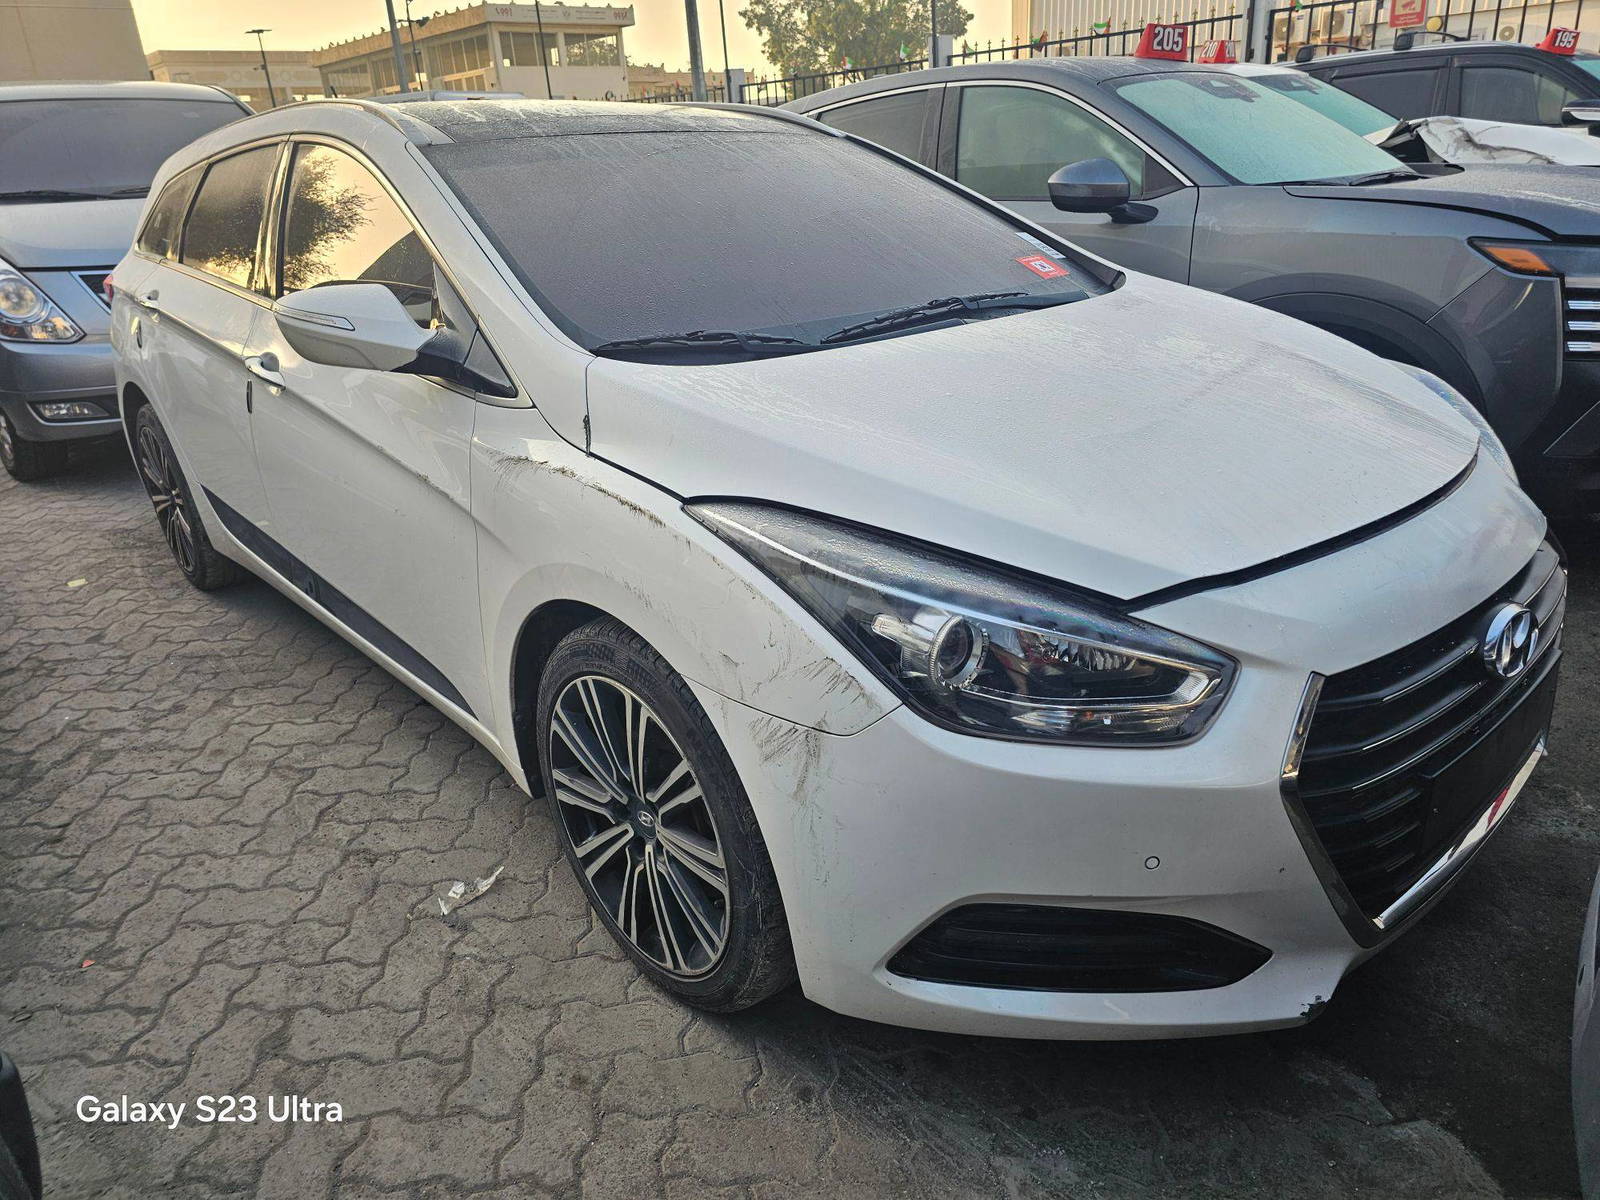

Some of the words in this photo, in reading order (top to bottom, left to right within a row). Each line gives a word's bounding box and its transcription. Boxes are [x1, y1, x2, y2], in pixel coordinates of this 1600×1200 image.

[1153, 27, 1183, 52] 205
[1555, 31, 1577, 48] 195
[1201, 42, 1217, 57] 210
